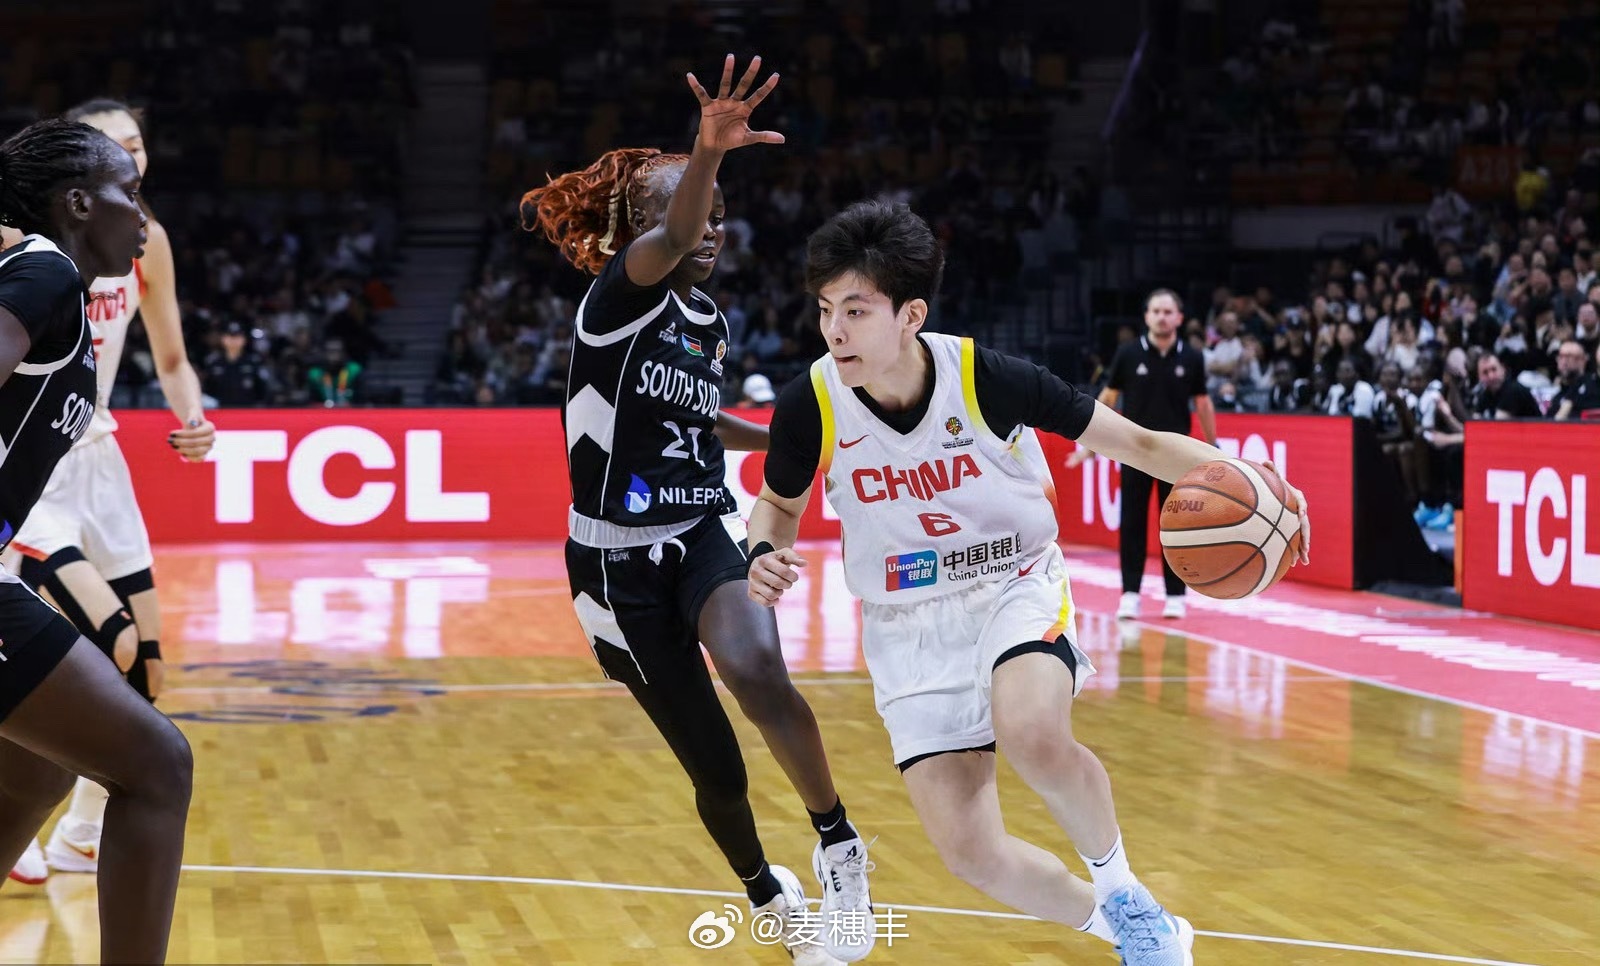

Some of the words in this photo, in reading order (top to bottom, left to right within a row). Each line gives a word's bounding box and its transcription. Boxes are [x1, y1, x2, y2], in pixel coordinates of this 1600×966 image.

[636, 360, 693, 407] SOUTH
[692, 378, 721, 421] SUD
[51, 392, 94, 445] SOU
[661, 420, 706, 467] 21
[181, 425, 491, 526] TCL
[852, 454, 982, 503] CHINA
[917, 512, 961, 537] 6
[1163, 499, 1205, 514] molte
[1486, 466, 1600, 589] TCL
[888, 558, 935, 573] UnionPay
[948, 570, 978, 582] China
